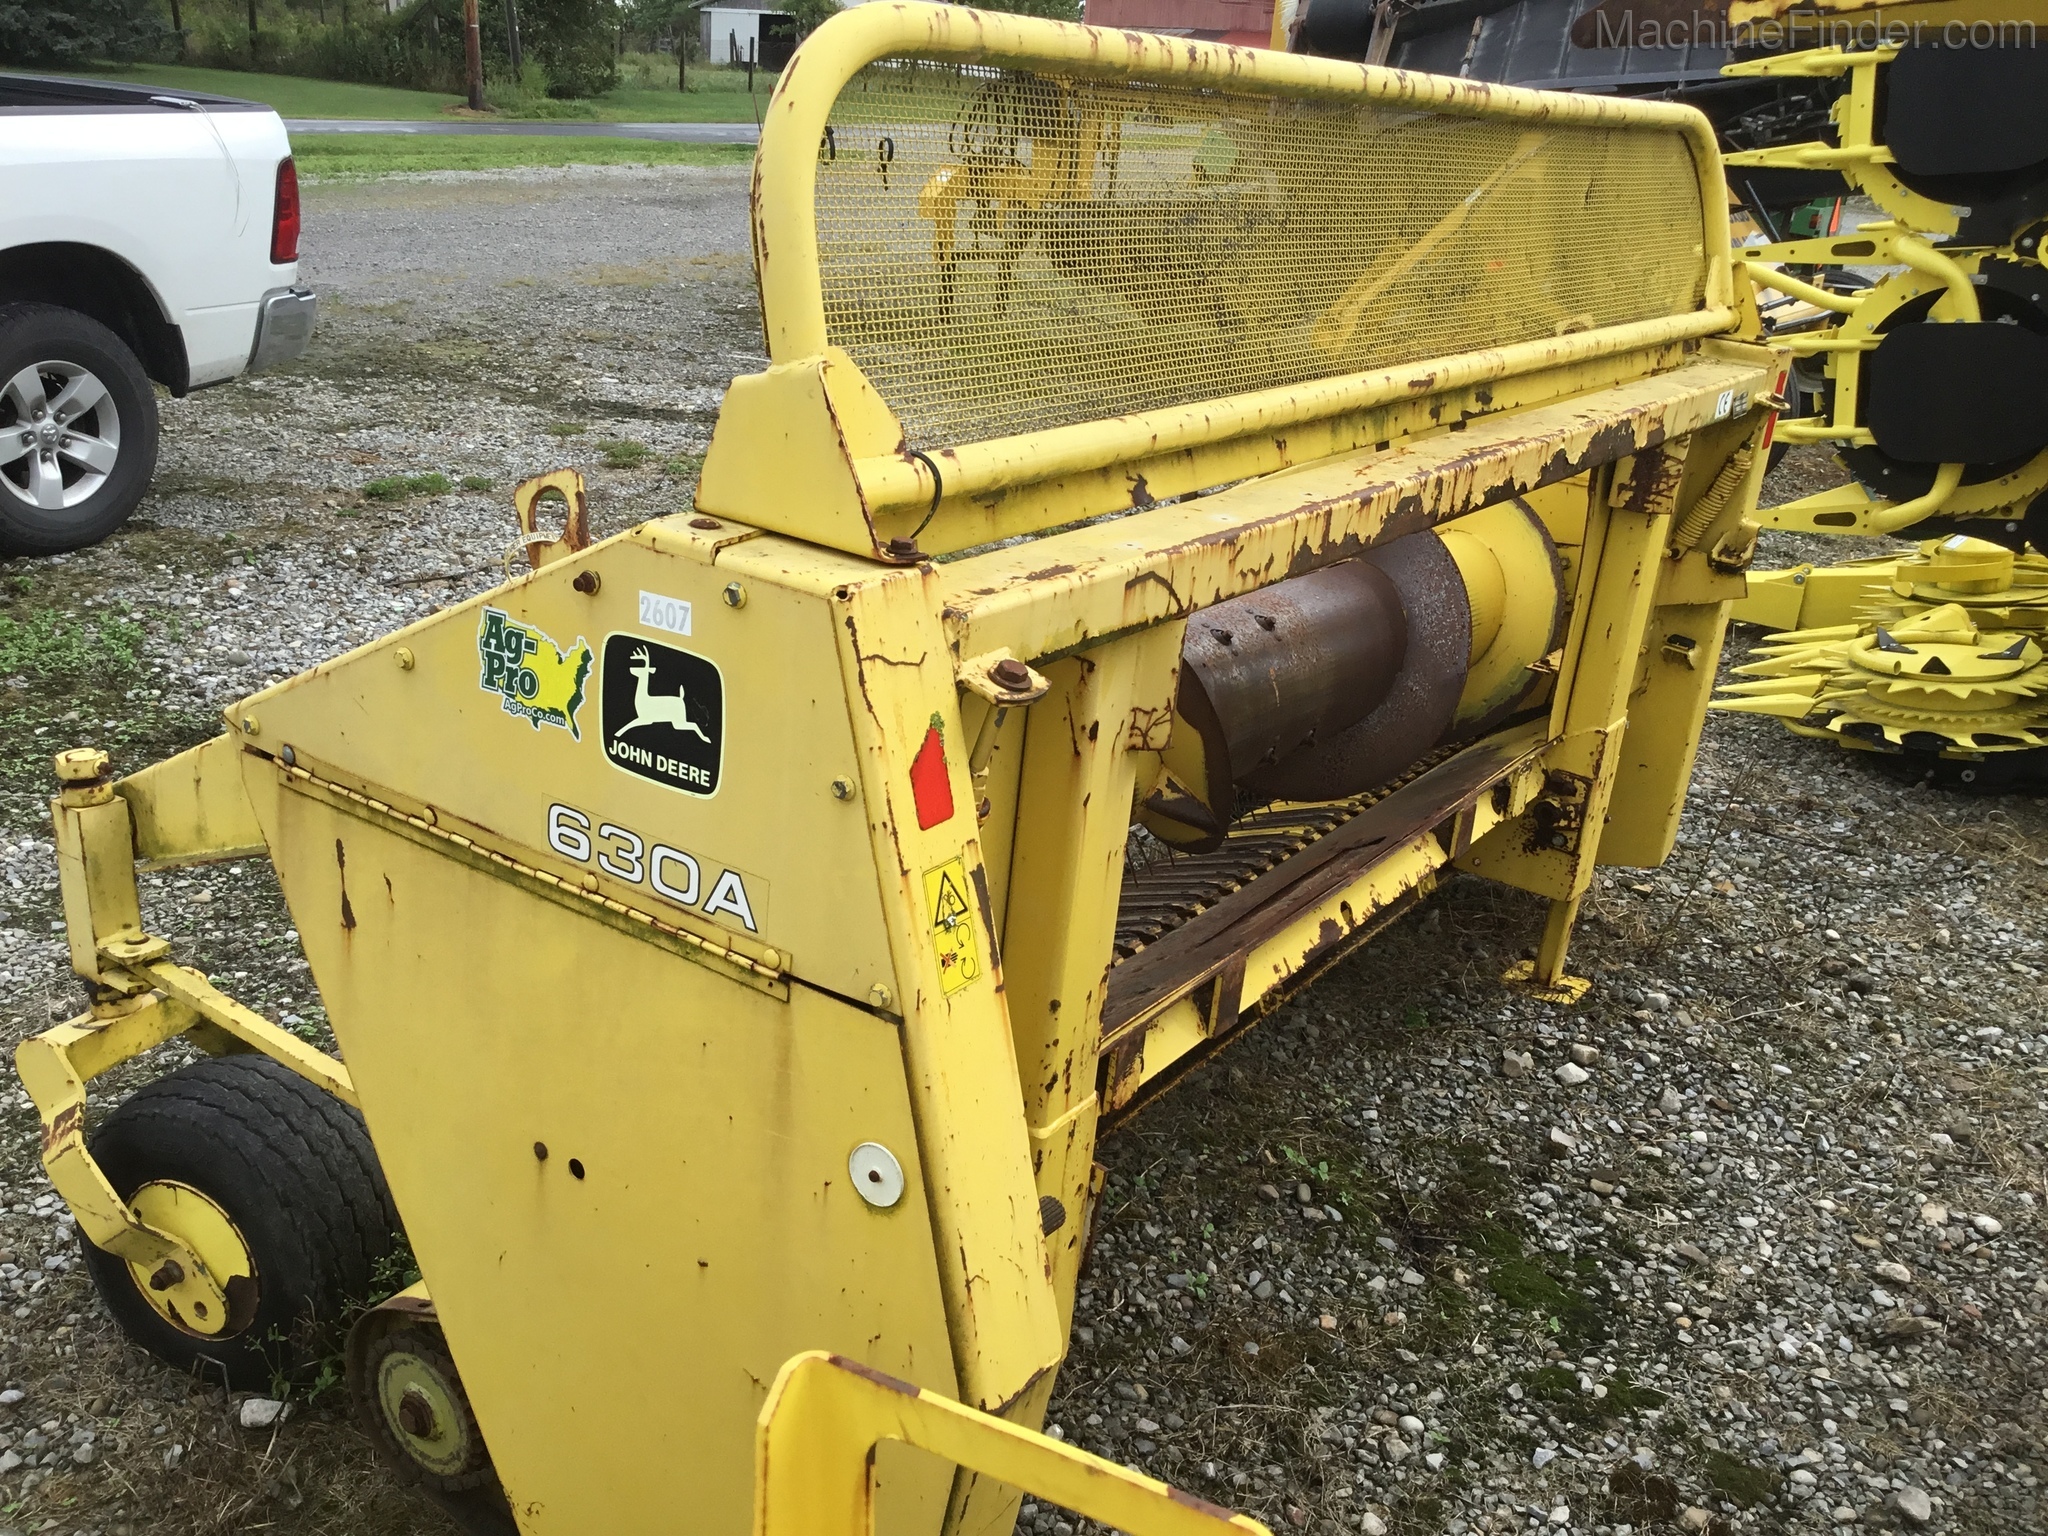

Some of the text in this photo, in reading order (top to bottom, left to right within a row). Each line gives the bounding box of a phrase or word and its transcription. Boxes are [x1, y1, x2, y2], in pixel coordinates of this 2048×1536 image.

[639, 595, 690, 631] 2607
[481, 610, 538, 666] Ag-
[482, 651, 539, 700] Pro
[504, 699, 565, 725] AgProCo.com
[609, 739, 711, 787] JOHN DEERE
[548, 803, 758, 933] 630A
